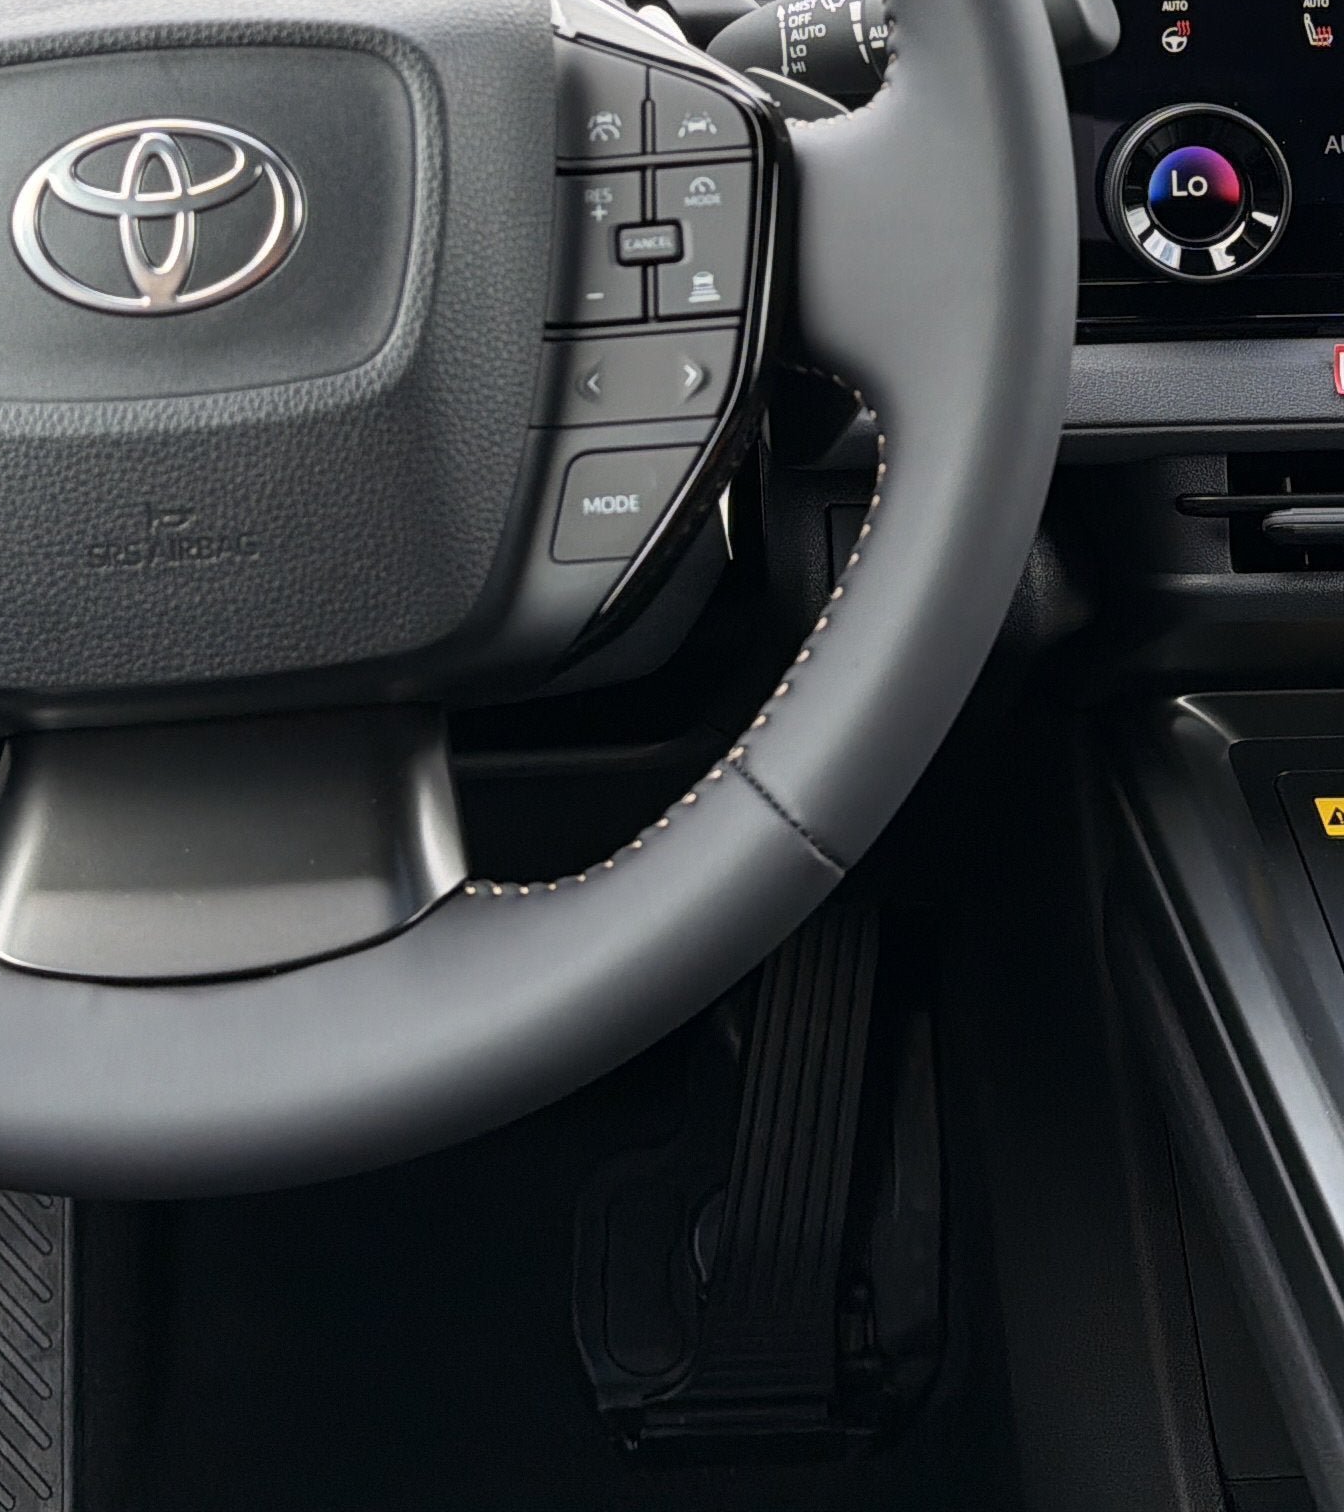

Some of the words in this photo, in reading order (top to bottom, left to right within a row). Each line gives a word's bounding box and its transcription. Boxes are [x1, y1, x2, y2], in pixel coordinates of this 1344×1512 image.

[1162, 0, 1188, 12] AUTO
[788, 12, 812, 28] OFF
[790, 24, 826, 42] AUTO
[869, 24, 888, 40] AU
[789, 44, 807, 59] LO
[791, 61, 806, 74] HI
[1172, 170, 1208, 199] Lo
[582, 493, 640, 516] MODE
